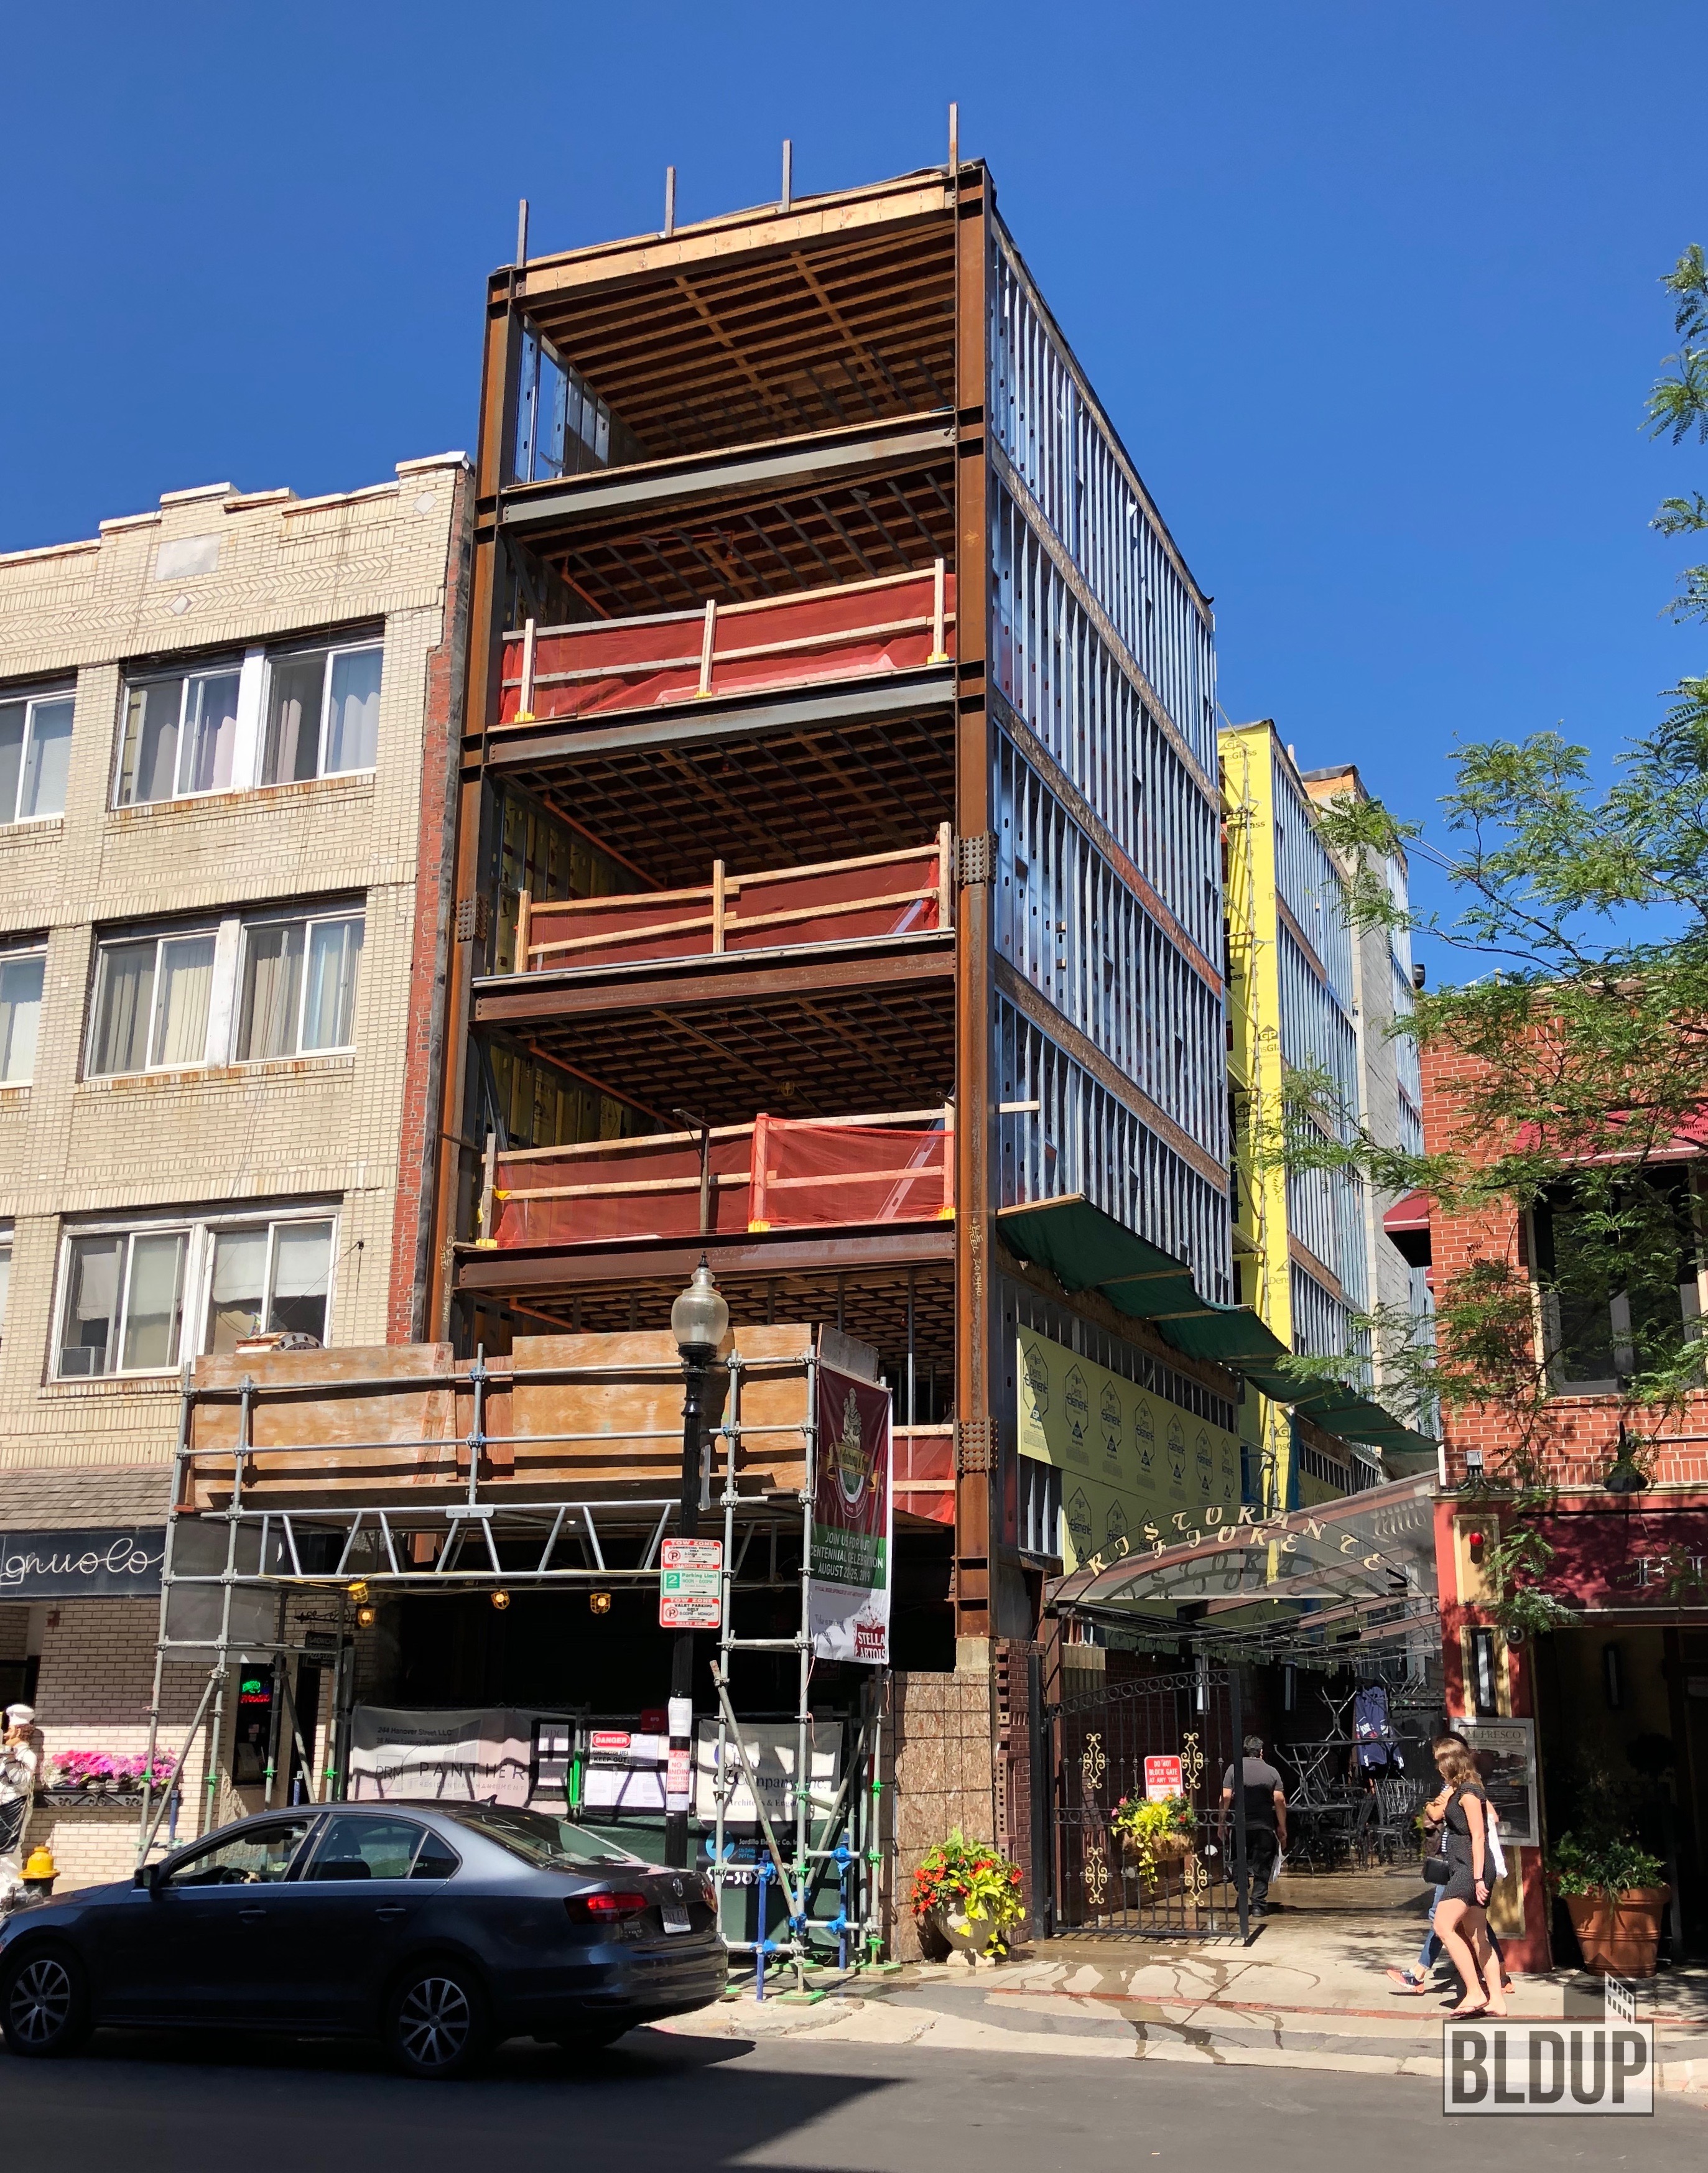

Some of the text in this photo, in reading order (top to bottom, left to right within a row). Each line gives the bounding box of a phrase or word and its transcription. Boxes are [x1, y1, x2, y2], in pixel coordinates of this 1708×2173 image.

[1260, 1031, 1278, 1040] GP
[825, 1532, 840, 1544] JOIN
[848, 1536, 860, 1549] FOR
[1087, 1506, 1385, 1577] RISTORANTE
[1152, 1524, 1299, 1559] FIORE
[810, 1544, 883, 1568] CENTENNIAL CELEBRATION
[817, 1562, 870, 1582] AUGUST 22-25, 2019
[668, 1575, 678, 1584] 2
[858, 1631, 886, 1646] STELLA
[860, 1647, 886, 1659] ARTOIS
[595, 1736, 628, 1744] DANGER
[1465, 1730, 1521, 1739] AL FRESCO
[1162, 1759, 1172, 1768] NOT
[375, 1765, 404, 1781] PRM
[419, 1761, 525, 1781] PANTHER
[475, 1782, 525, 1791] MANAGEMENT
[766, 1799, 773, 1807] &
